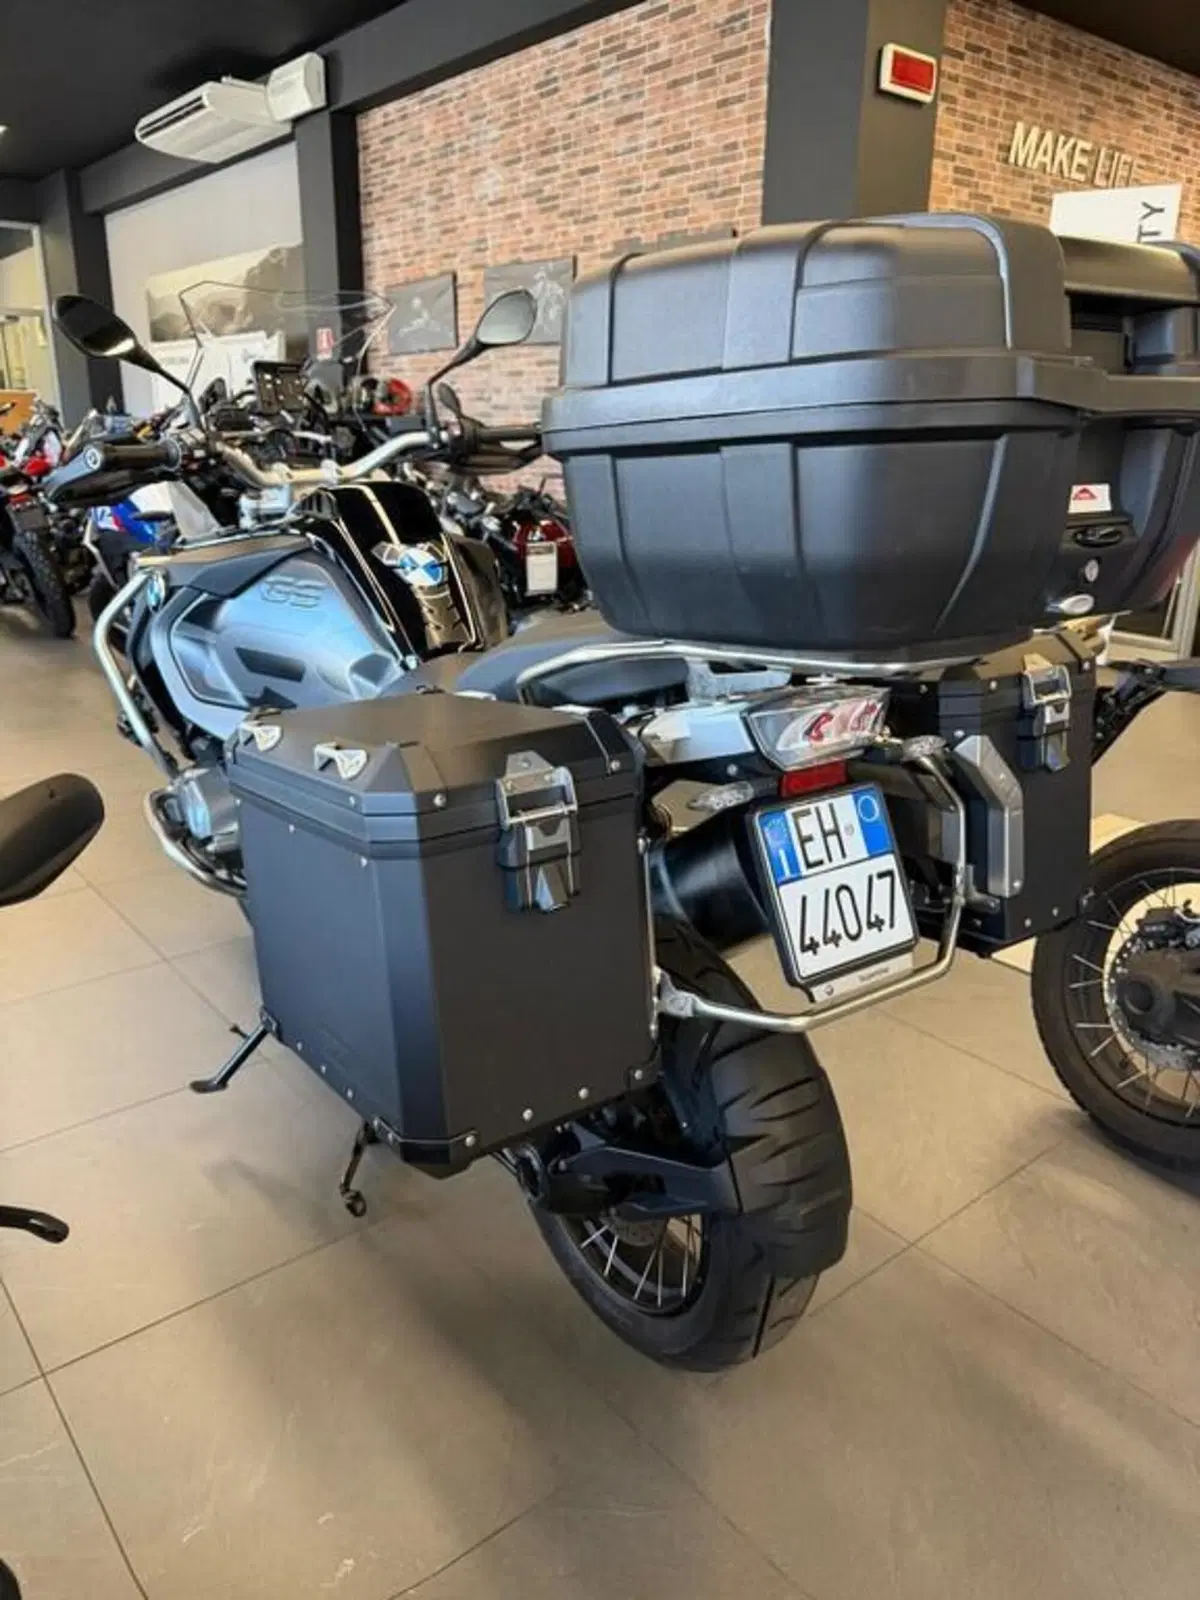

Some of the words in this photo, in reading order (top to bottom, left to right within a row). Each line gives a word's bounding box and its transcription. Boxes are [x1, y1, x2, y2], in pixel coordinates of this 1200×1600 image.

[1008, 121, 1092, 182] MAKE
[791, 802, 847, 870] EH
[799, 869, 896, 956] 44047
